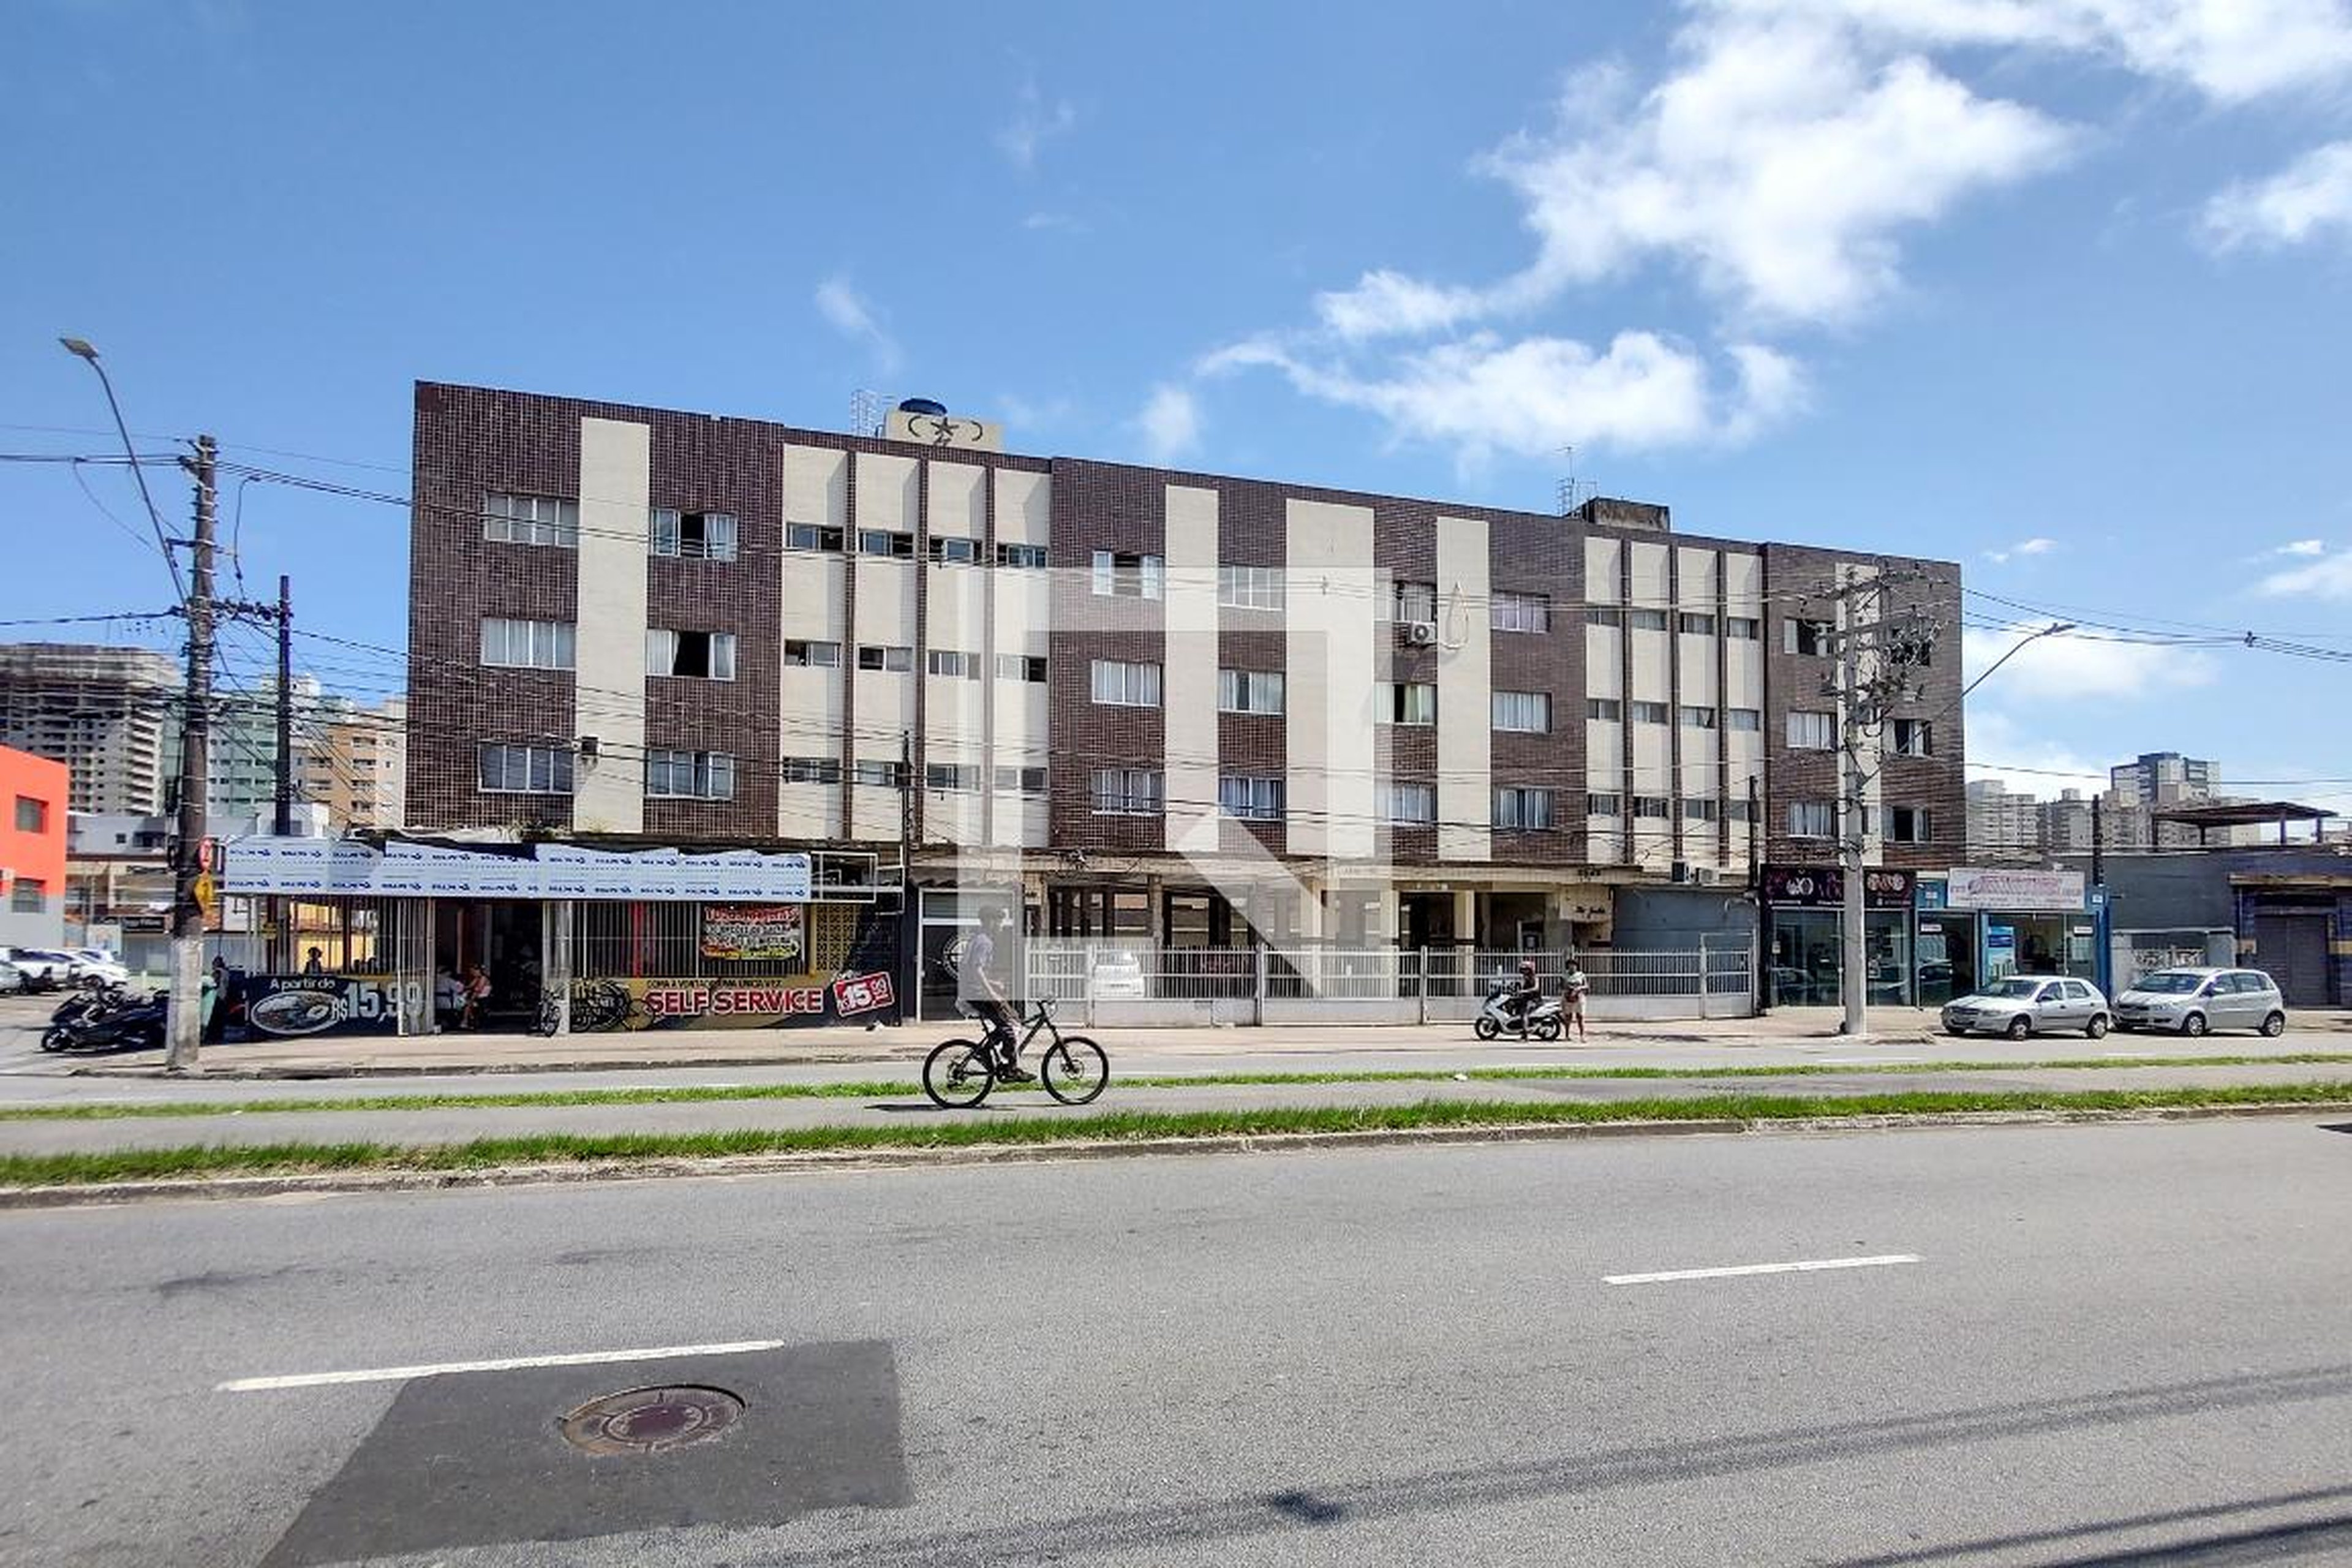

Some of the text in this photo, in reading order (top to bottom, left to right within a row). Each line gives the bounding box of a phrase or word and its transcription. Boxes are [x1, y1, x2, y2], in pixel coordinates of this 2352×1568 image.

[270, 978, 336, 992] A partir de
[344, 982, 421, 1022] 15,99
[644, 988, 823, 1015] SELF SERVICE
